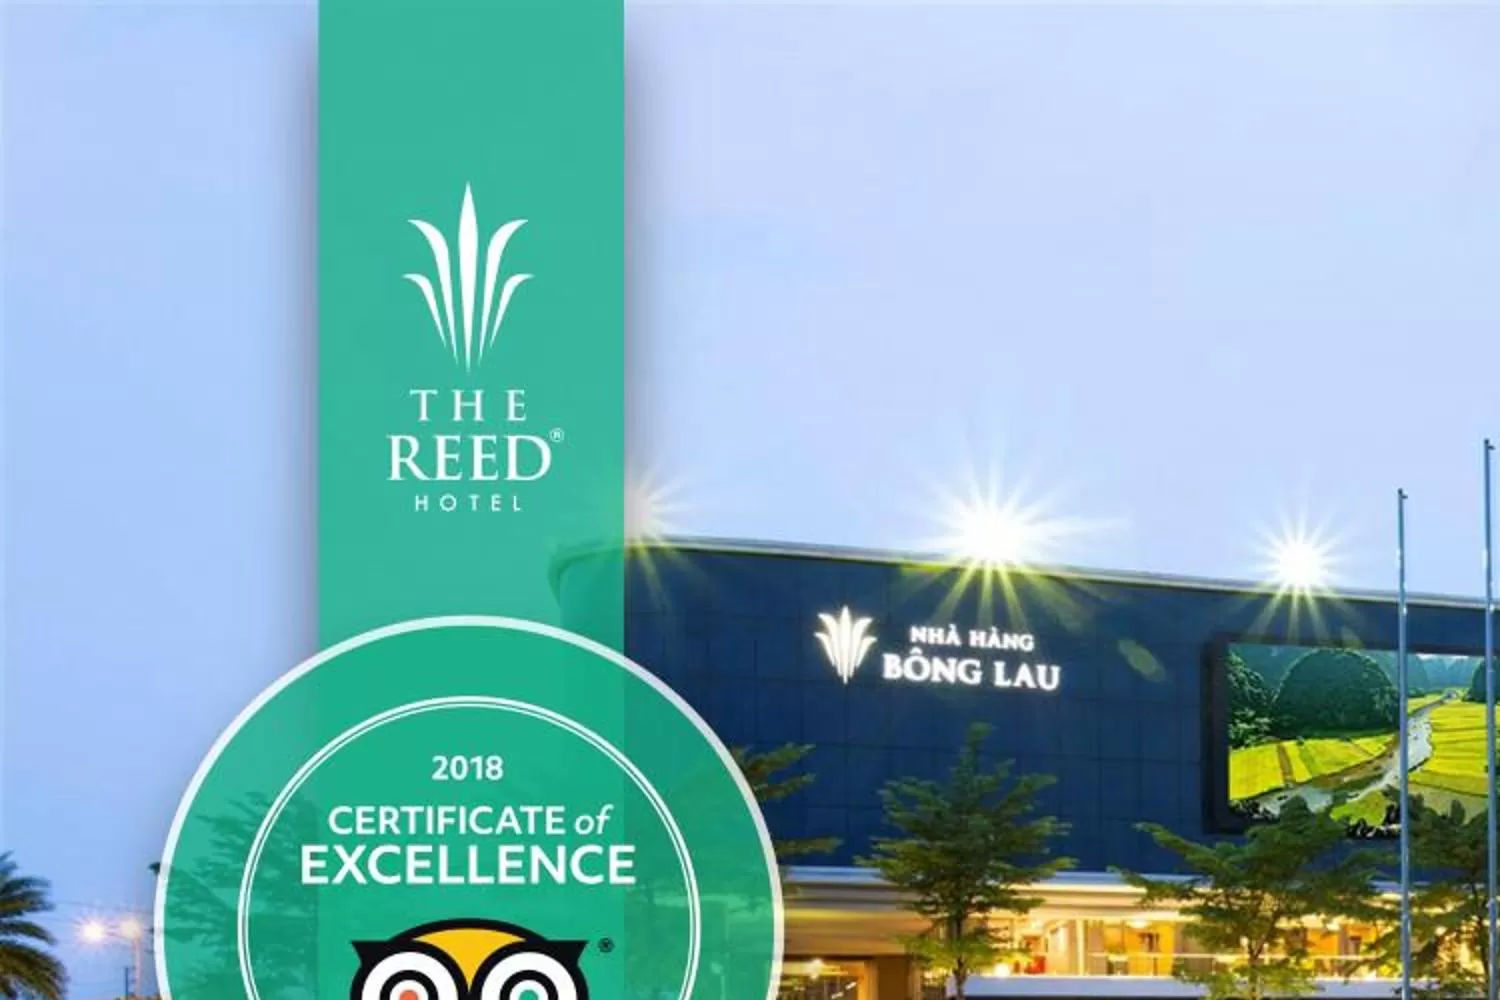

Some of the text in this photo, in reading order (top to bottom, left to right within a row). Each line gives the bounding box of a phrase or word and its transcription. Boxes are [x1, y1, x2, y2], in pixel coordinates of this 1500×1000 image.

[910, 624, 1034, 652] NHÀ HÀNG
[882, 647, 1061, 691] BÔNG LAU
